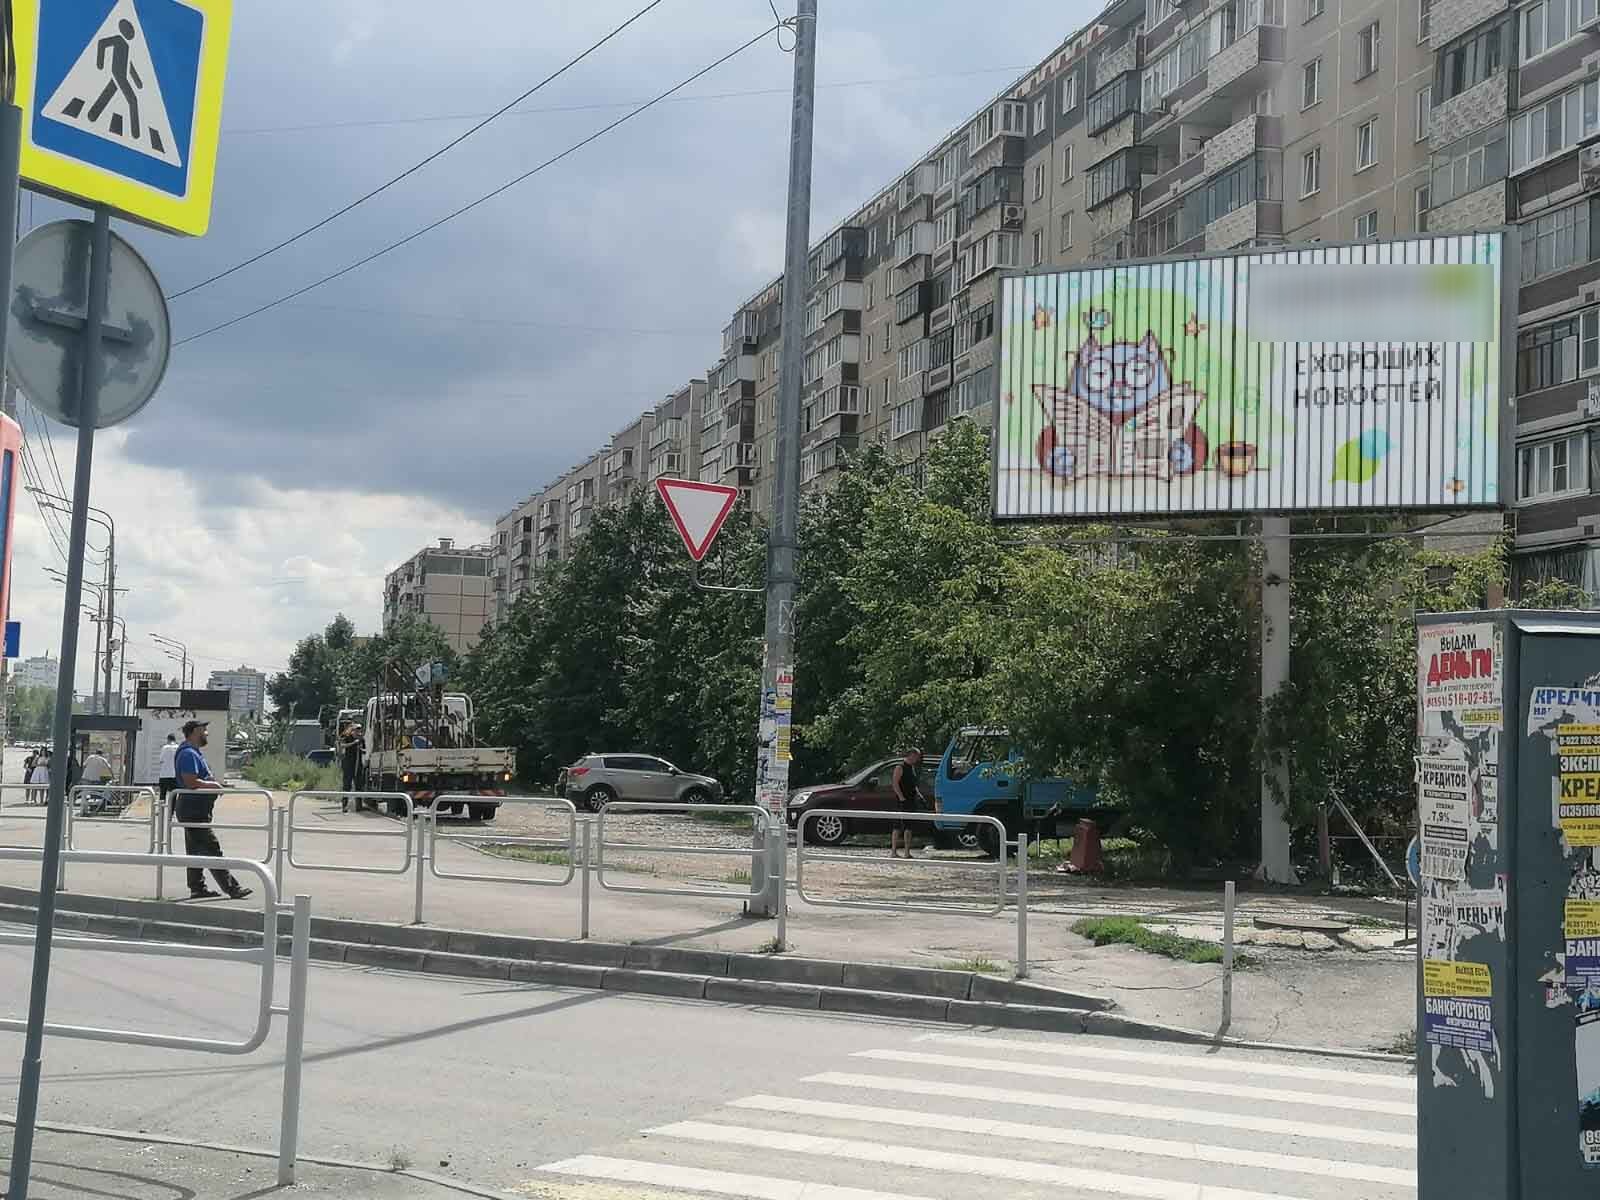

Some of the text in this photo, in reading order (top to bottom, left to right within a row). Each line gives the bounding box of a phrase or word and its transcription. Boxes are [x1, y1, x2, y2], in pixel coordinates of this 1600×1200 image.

[1311, 347, 1441, 373] ХОРОШИХ
[1294, 376, 1441, 408] НОВОСТЕЙ
[1440, 633, 1477, 651] ВЫДАМ
[1426, 648, 1492, 686] ДЕНЬГИ
[1424, 770, 1467, 789] КРЕДИТОВ
[1425, 998, 1491, 1022] БАНКРОТСТВО
